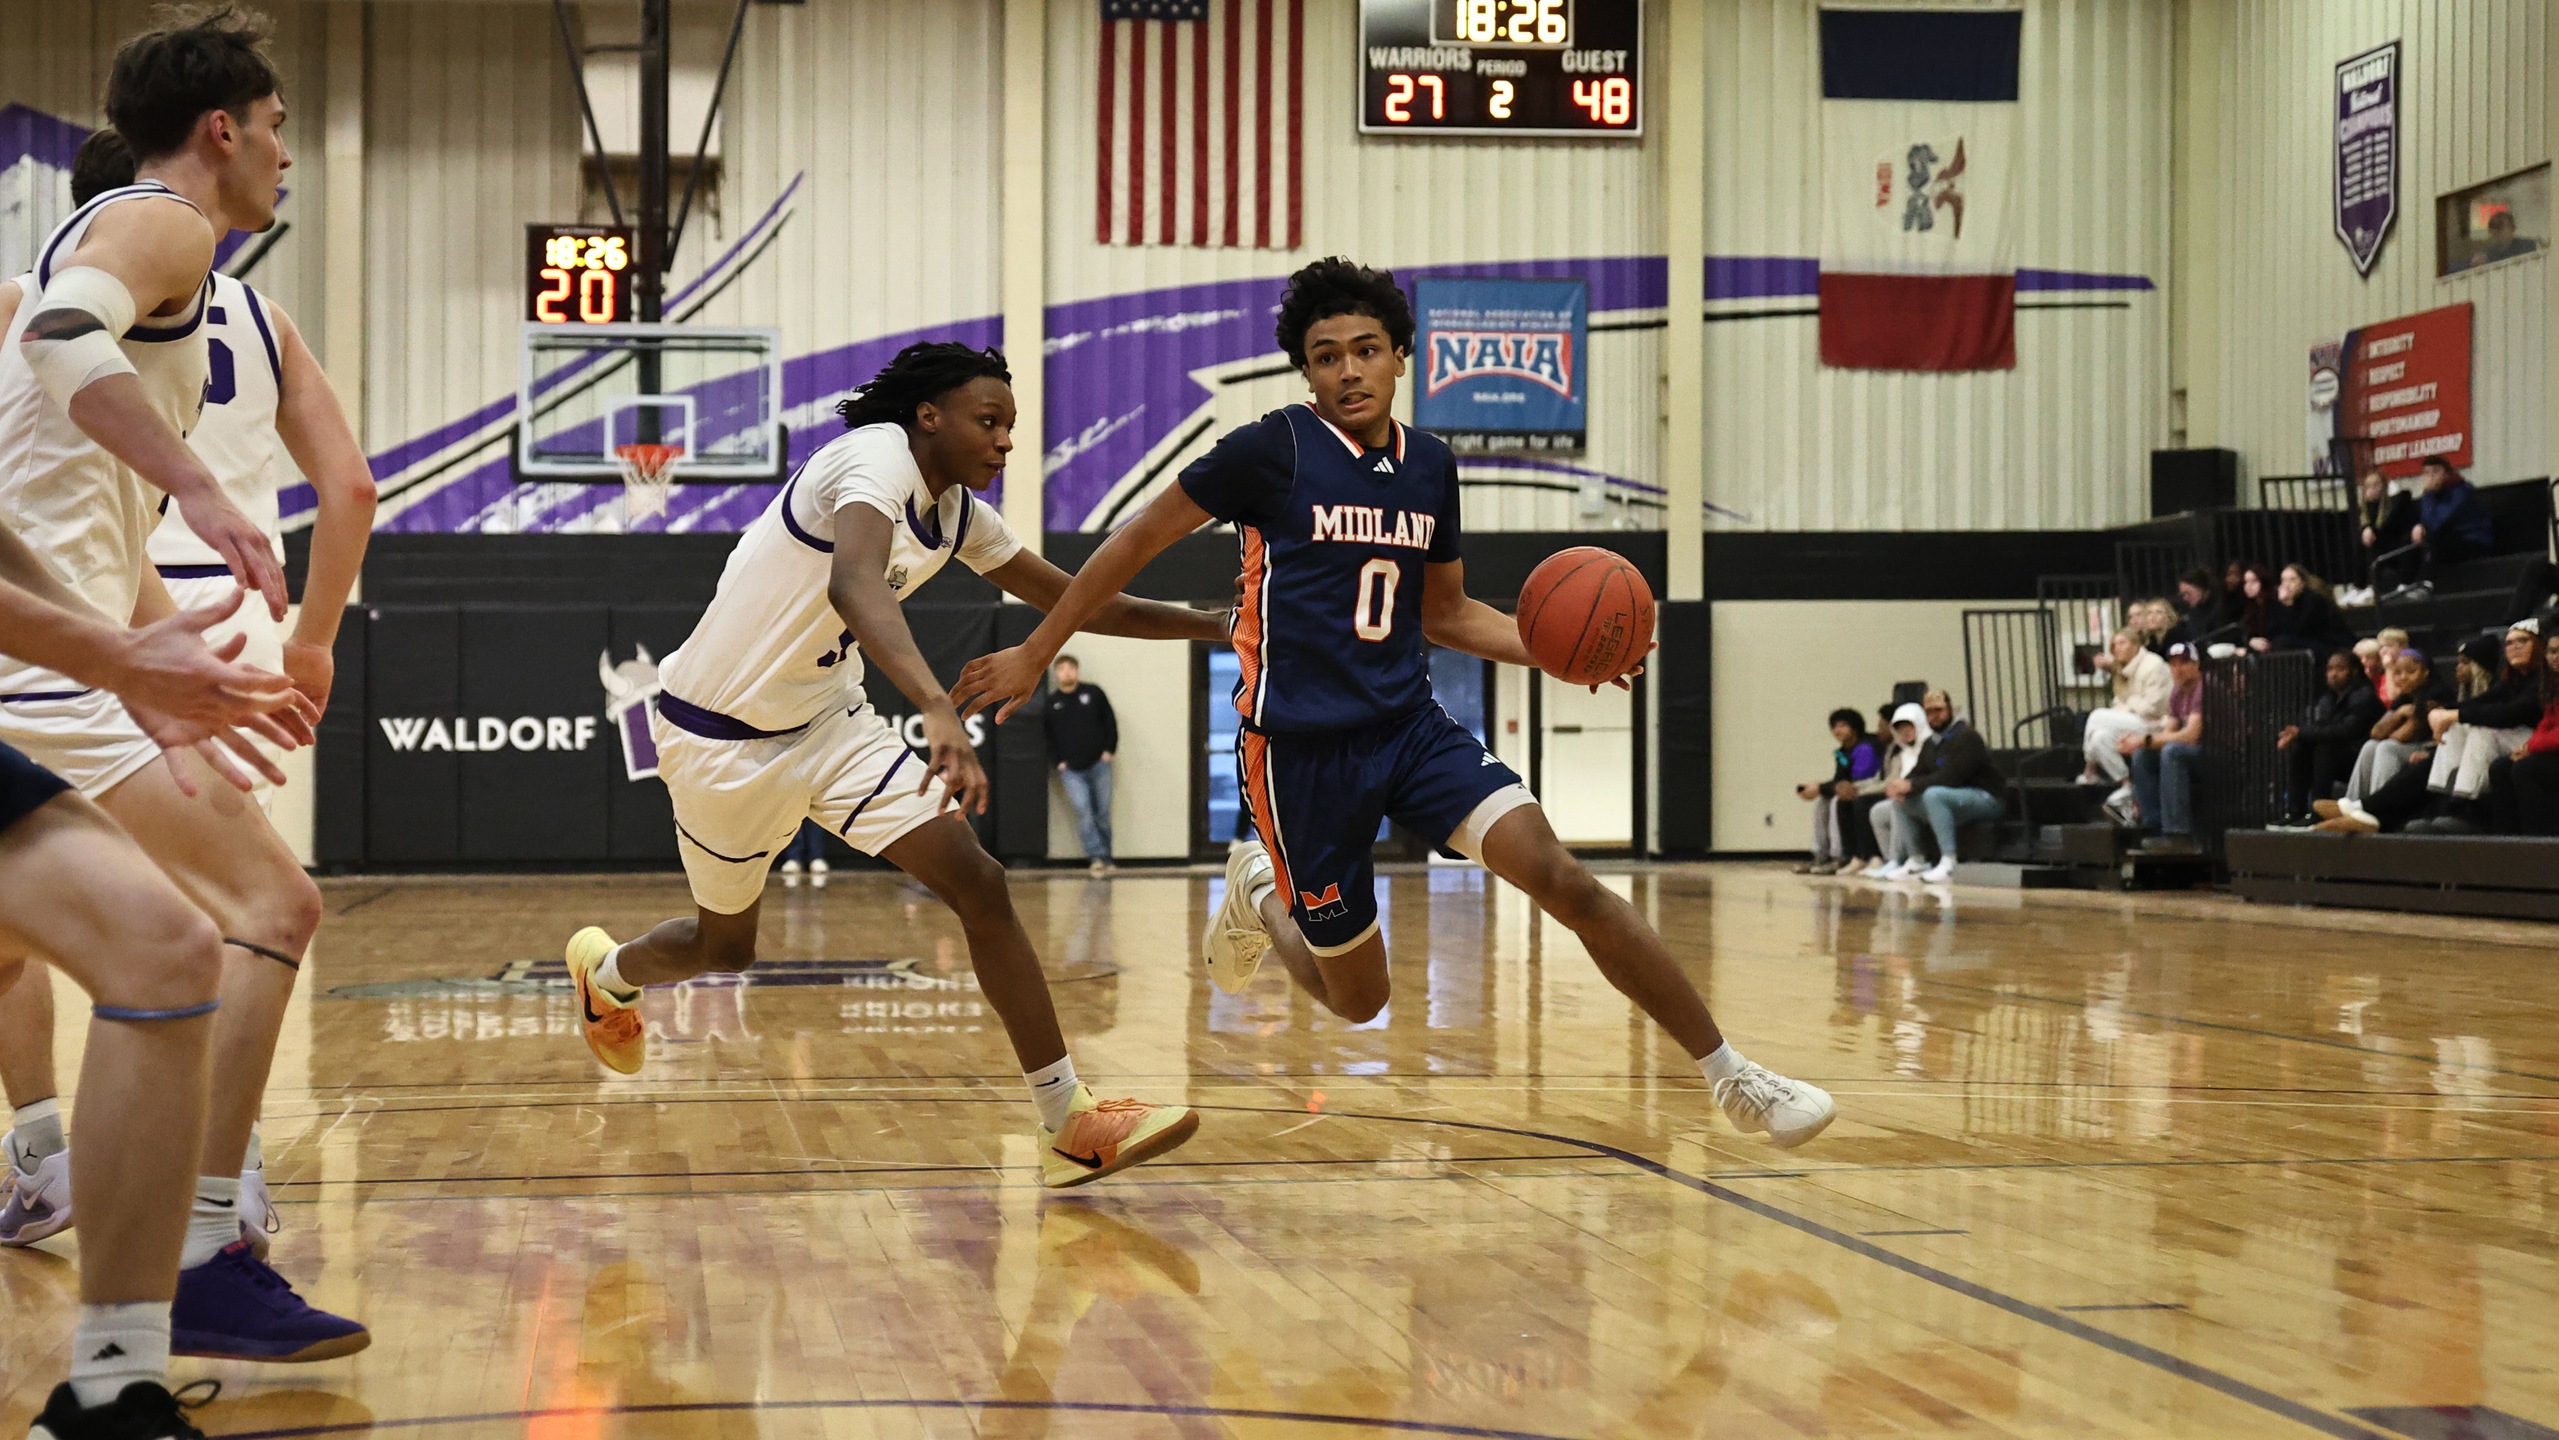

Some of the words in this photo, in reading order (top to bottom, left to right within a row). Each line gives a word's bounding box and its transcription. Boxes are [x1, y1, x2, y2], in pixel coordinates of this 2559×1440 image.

[1456, 0, 1567, 43] 18:26
[1369, 47, 1473, 71] WARRIORS
[1477, 60, 1527, 77] PERIOD
[1562, 49, 1628, 73] GUEST
[1385, 75, 1444, 122] 27
[1490, 80, 1514, 119] 2
[1573, 78, 1630, 124] 48
[546, 235, 628, 270] 18:26
[536, 268, 615, 324] 20
[1430, 333, 1569, 393] NAIA
[2369, 332, 2415, 359] INTEGRITY
[2369, 361, 2405, 385] RESPECT
[2369, 382, 2437, 412] RESPONSIBILITY
[2370, 409, 2440, 438] SPORTSMANSHIP
[1451, 434, 1484, 451] right
[1488, 436, 1525, 451] game
[1529, 434, 1549, 447] for
[1552, 435, 1575, 448] life
[1312, 504, 1436, 550] MIDLAND
[1354, 557, 1401, 643] 0
[379, 716, 598, 751] WALDORF
[1300, 882, 1348, 922] M
